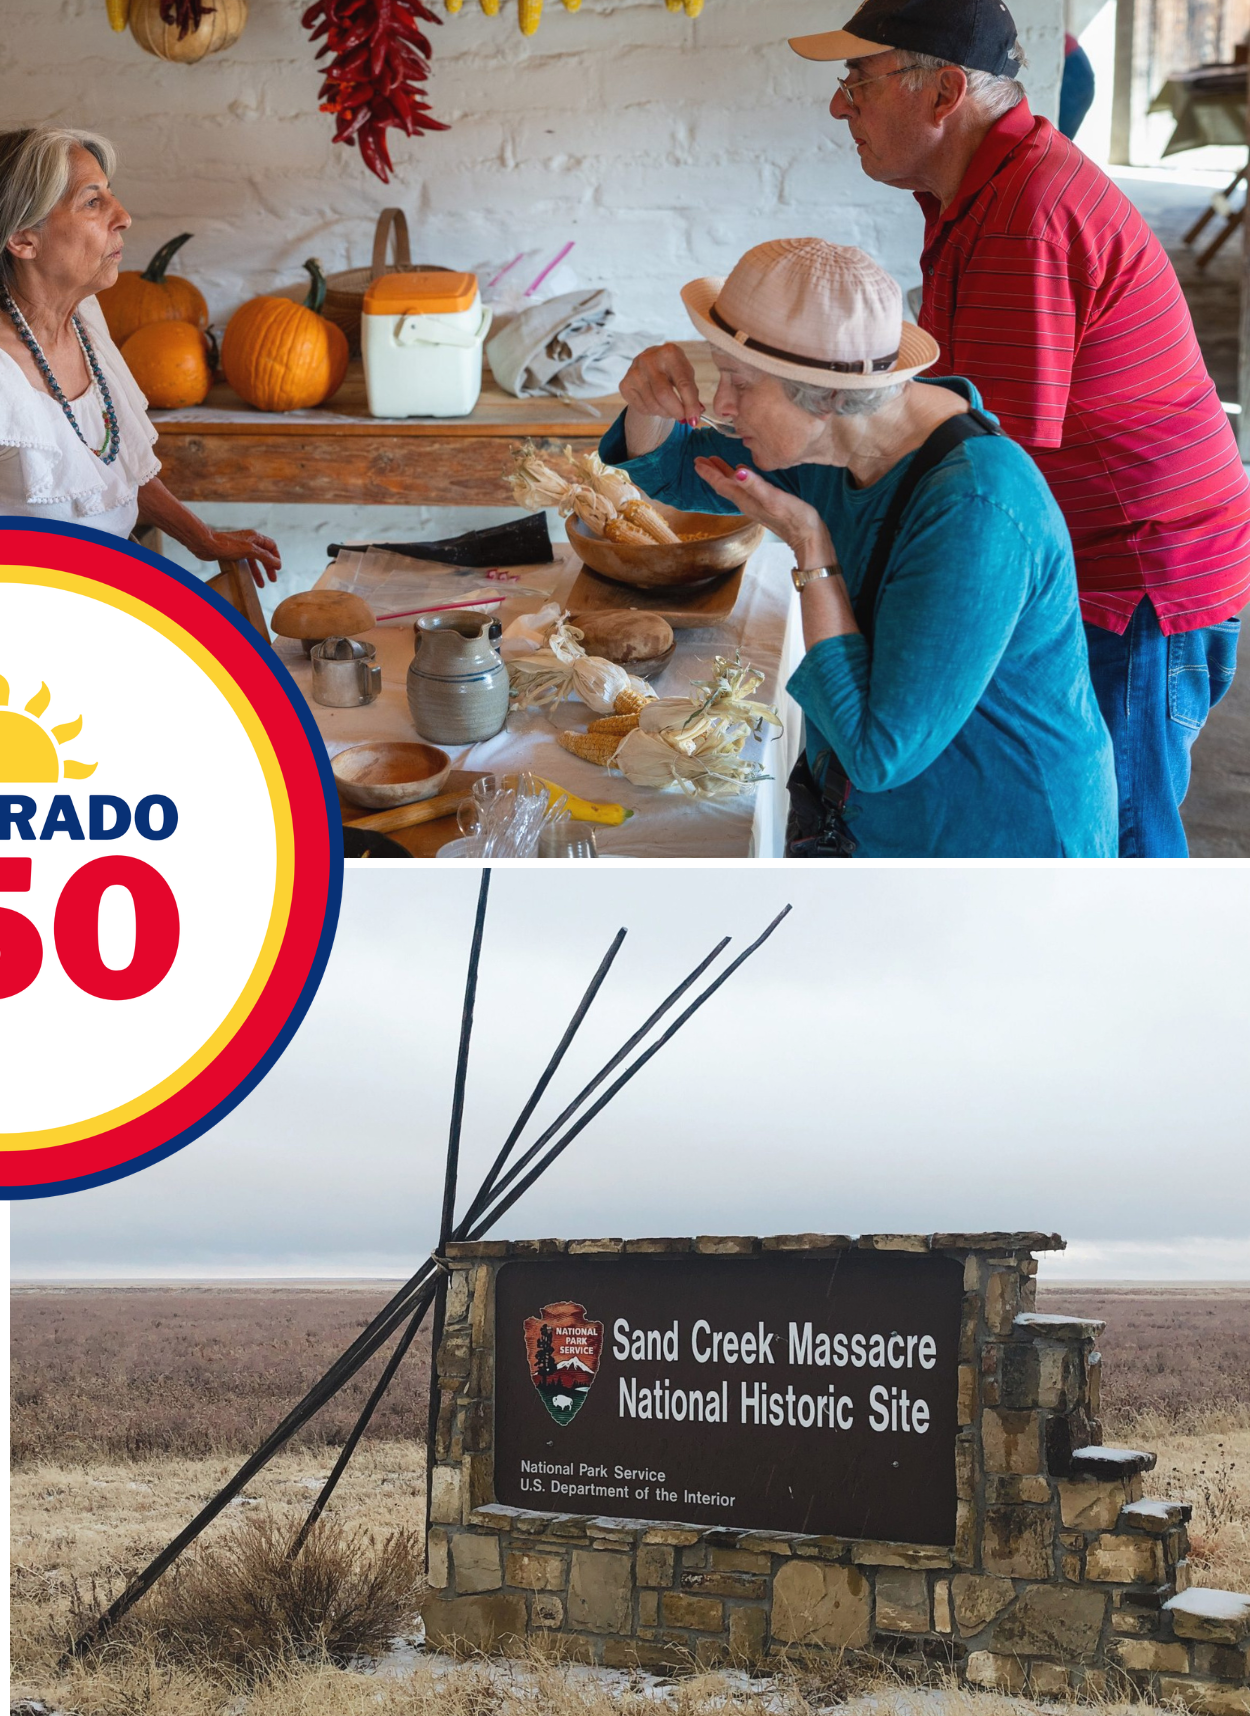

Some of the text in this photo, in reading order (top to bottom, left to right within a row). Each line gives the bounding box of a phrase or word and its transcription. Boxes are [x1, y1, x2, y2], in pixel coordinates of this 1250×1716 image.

[555, 1327, 598, 1336] NATIONAL
[565, 1337, 588, 1345] PARK
[559, 1346, 594, 1355] SERVICE
[612, 1317, 937, 1370] Sand Creek Massacre
[619, 1376, 930, 1434] National Historic Site
[521, 1460, 667, 1482] National Park Service
[520, 1478, 736, 1507] U.S. Department of the Interior
